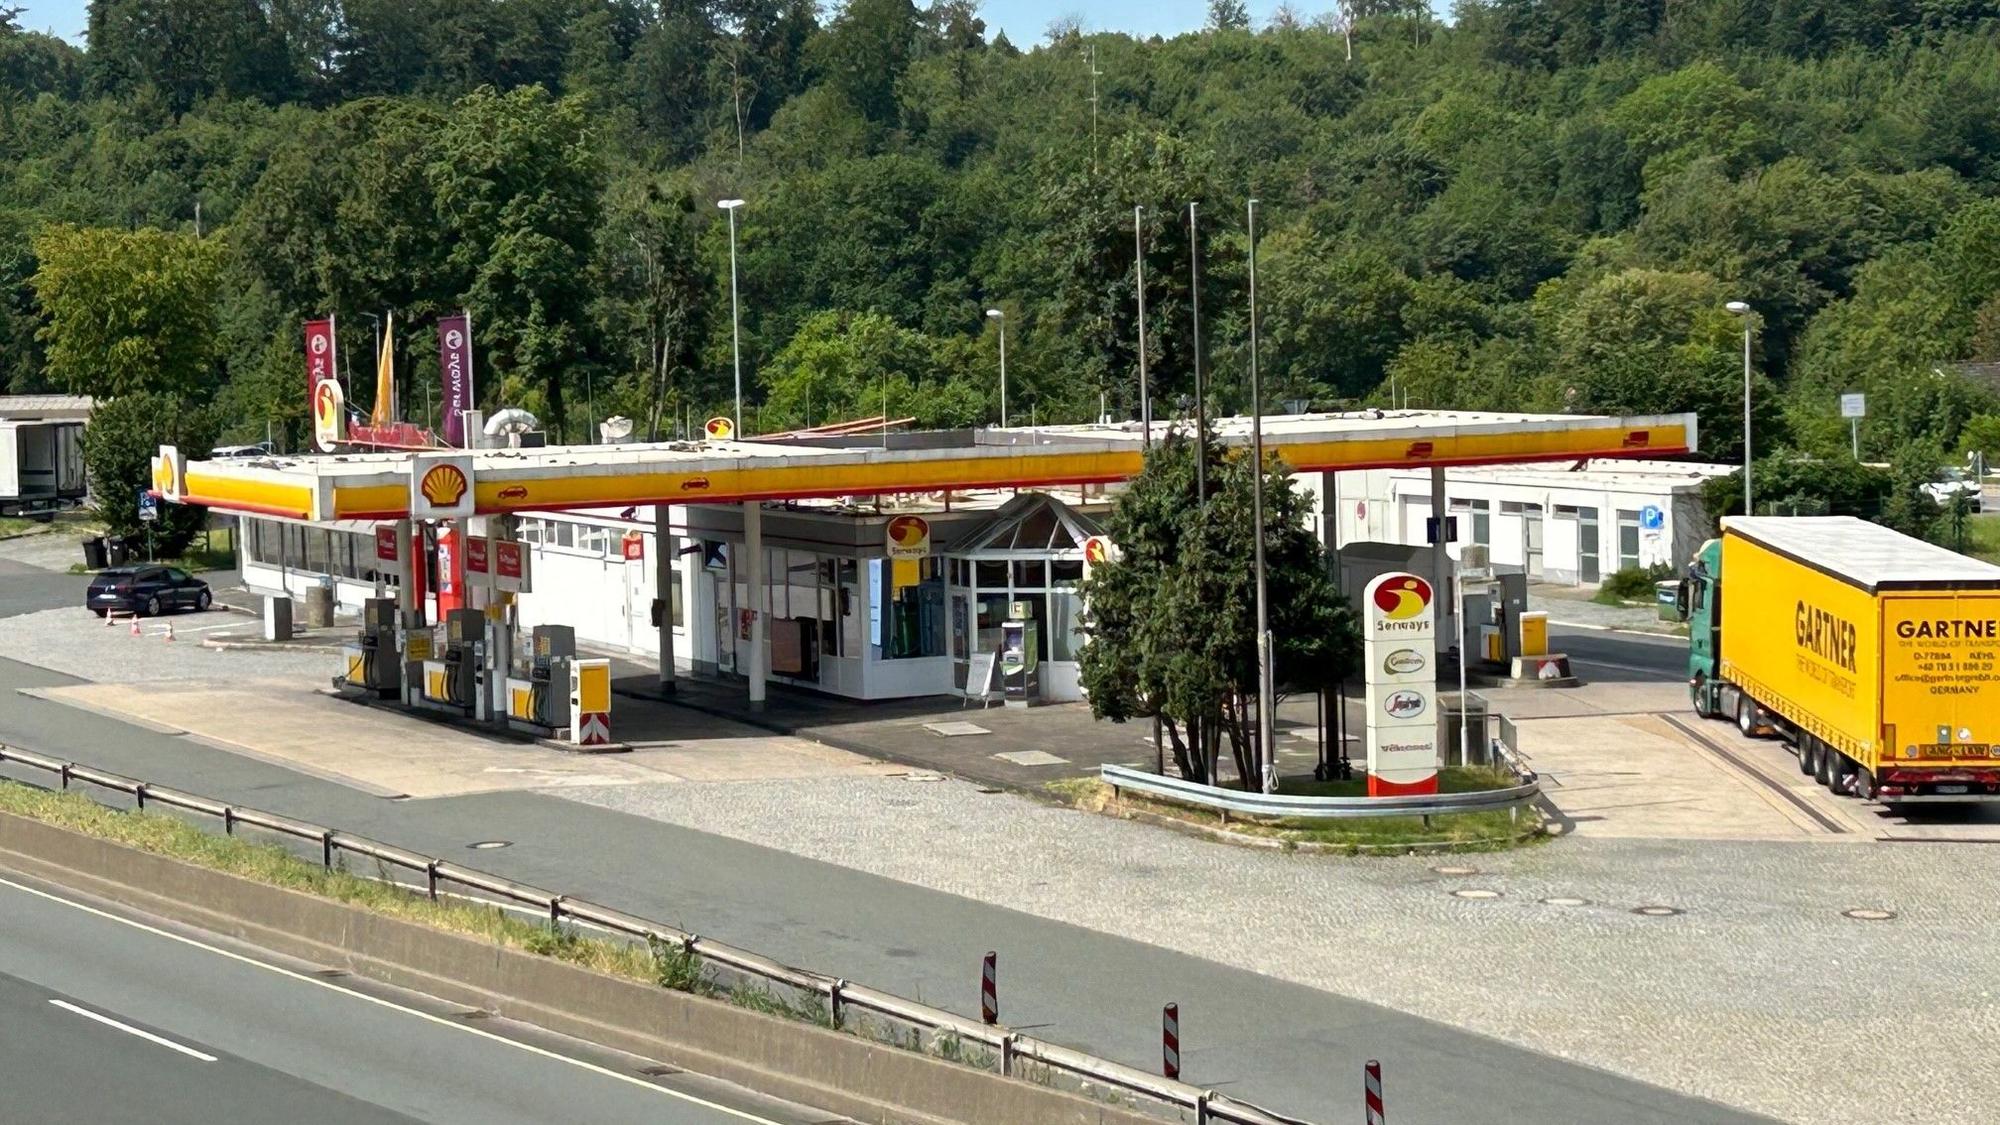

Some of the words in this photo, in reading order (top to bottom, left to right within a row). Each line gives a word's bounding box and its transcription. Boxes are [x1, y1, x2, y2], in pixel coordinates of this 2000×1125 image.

[1377, 620, 1430, 631] Serways
[1896, 620, 2000, 638] GARTNE
[1796, 600, 1857, 674] GARTNER
